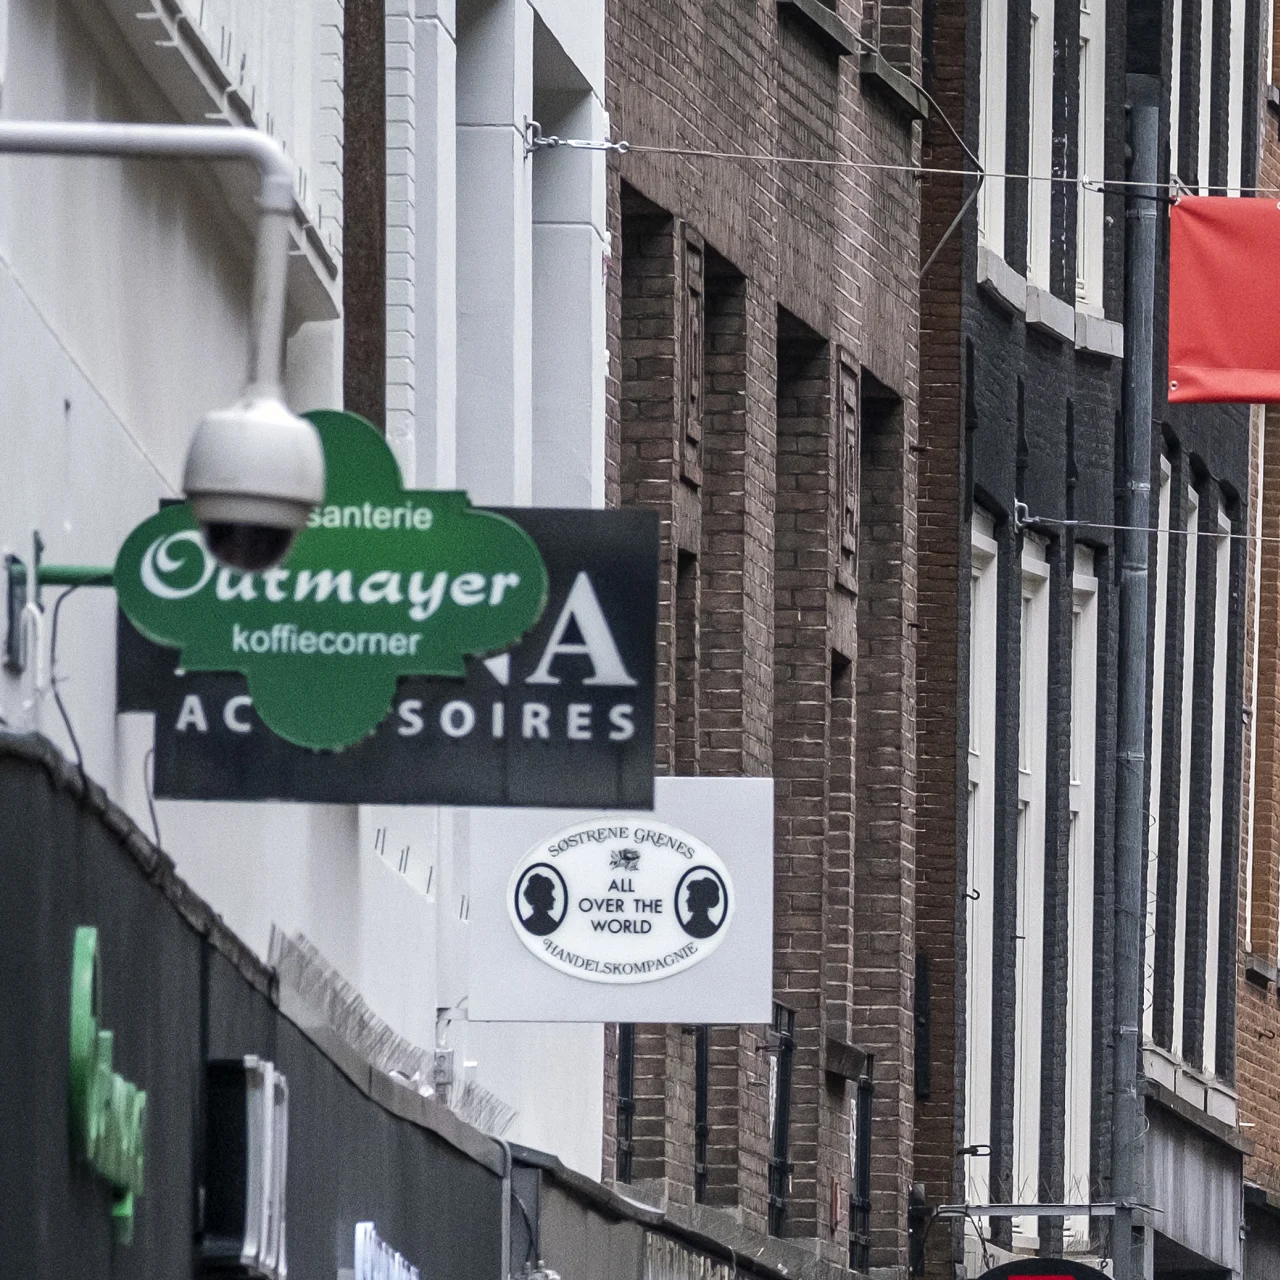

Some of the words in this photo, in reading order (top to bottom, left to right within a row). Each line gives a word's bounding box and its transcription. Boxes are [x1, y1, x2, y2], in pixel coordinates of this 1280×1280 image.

[232, 623, 423, 656] koffiecorner
[174, 694, 636, 742] ACSOIRES
[547, 826, 630, 858] SØSTRENE
[633, 828, 696, 860] GRENES
[607, 878, 636, 893] ALL
[578, 898, 625, 913] OVER
[634, 899, 663, 914] THE
[590, 919, 653, 934] WORLD
[542, 938, 699, 975] HANDELSKOMPAGNIE
